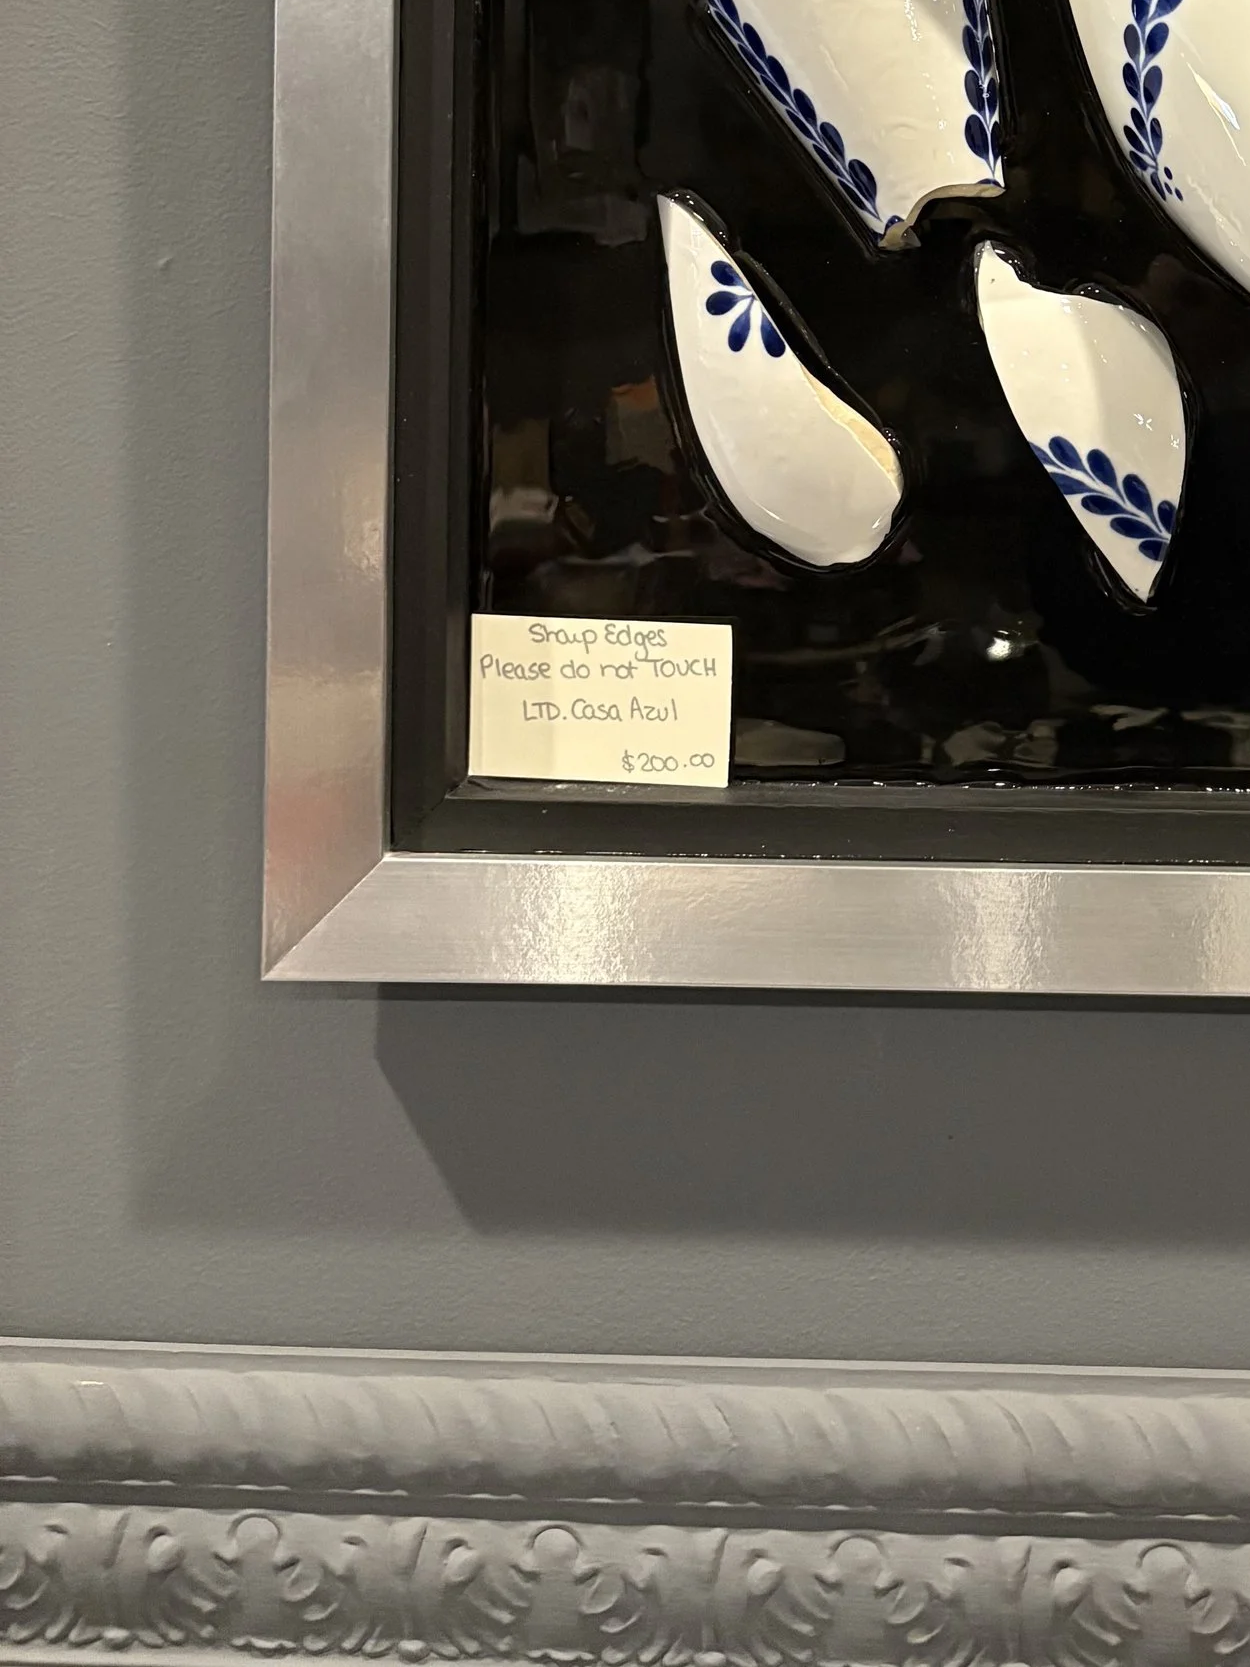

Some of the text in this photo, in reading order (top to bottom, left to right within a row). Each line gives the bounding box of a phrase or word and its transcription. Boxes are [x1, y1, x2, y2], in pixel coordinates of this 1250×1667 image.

[528, 622, 668, 662] Sharp Edges
[479, 653, 718, 681] Please do not TOUCH
[571, 697, 623, 722] Casa
[630, 696, 678, 722] Azul
[621, 749, 715, 774] $200.00
